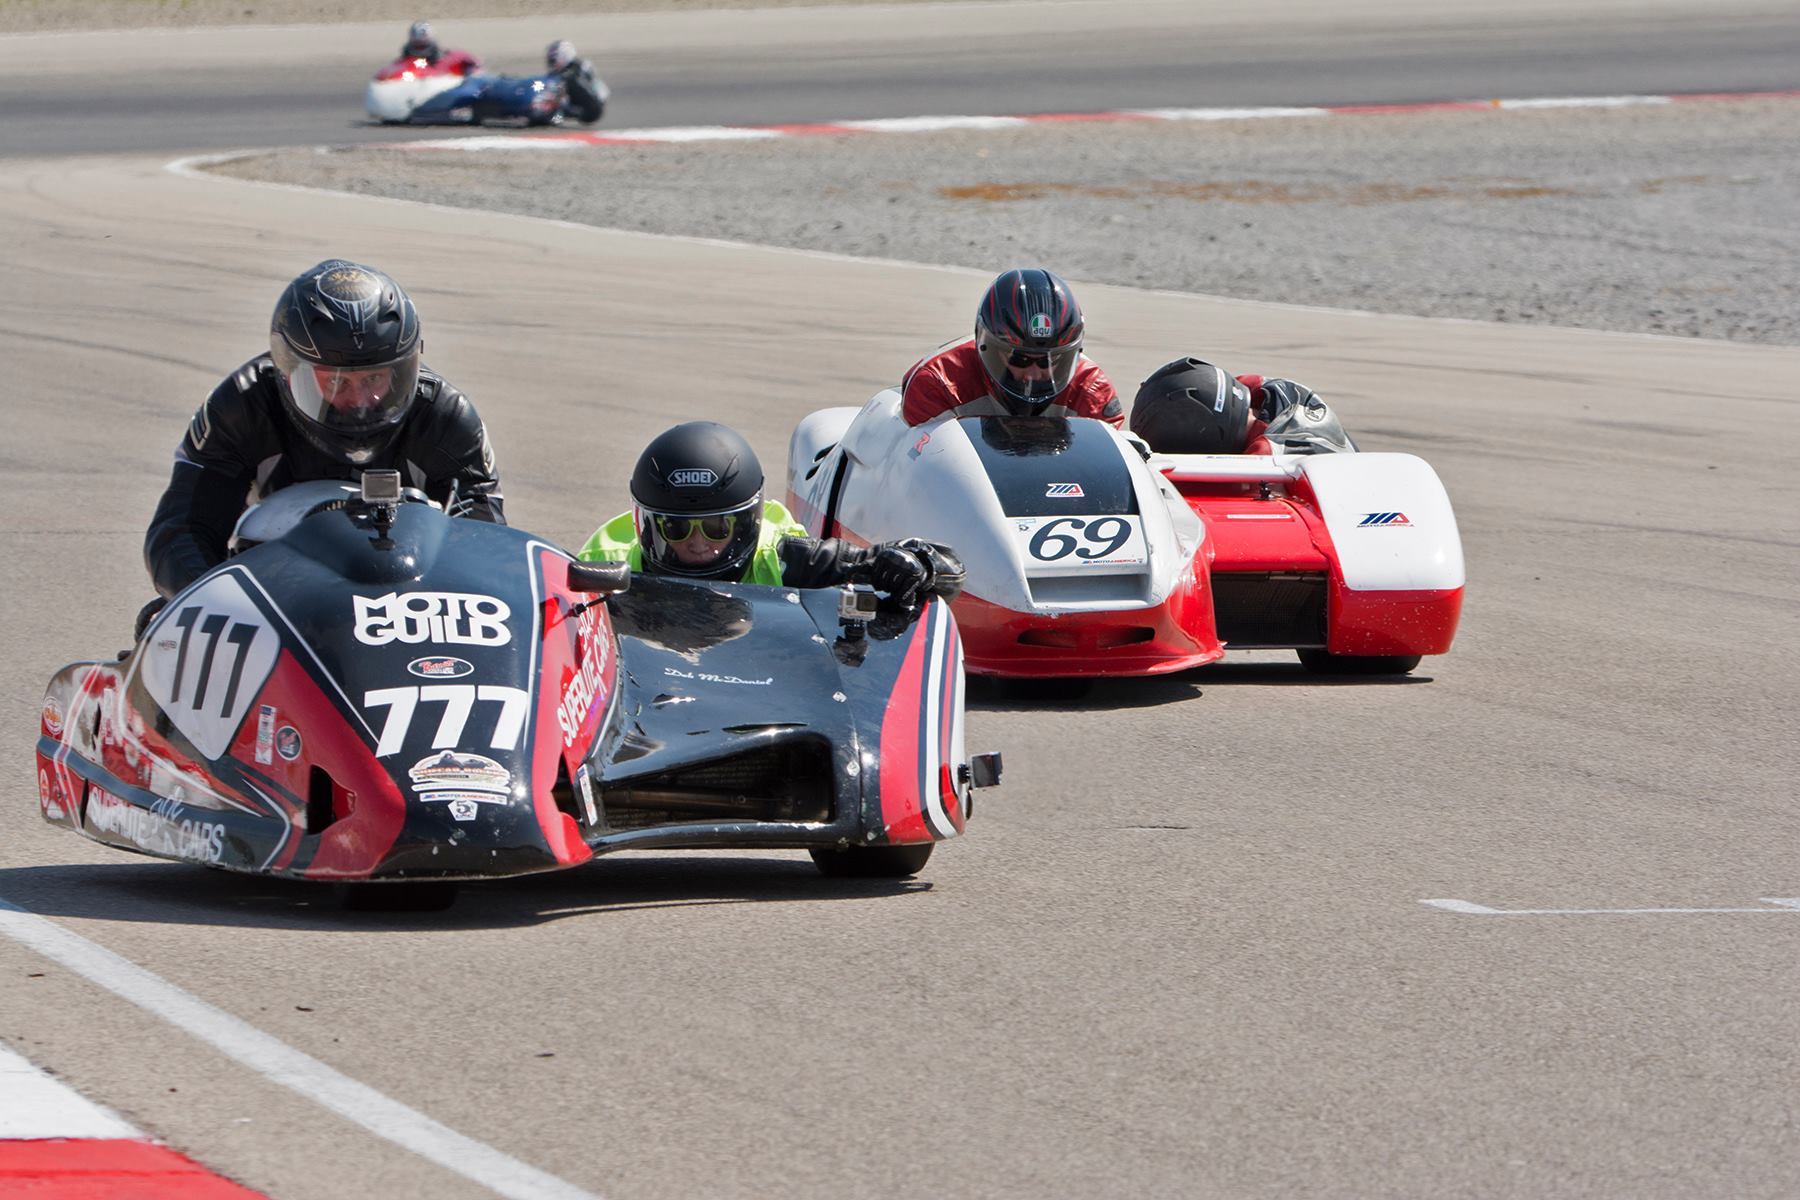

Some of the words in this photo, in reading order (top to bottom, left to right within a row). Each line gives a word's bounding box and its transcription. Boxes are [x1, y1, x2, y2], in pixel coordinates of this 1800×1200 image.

[673, 470, 712, 484] SHOEI
[1028, 517, 1132, 562] 69
[352, 591, 511, 622] MOTO
[353, 616, 512, 647] GUILD
[663, 667, 695, 679] Deb
[697, 673, 774, 686] McDaniel
[556, 646, 601, 748] SUPERLITE
[363, 685, 528, 758] 777
[178, 818, 226, 864] CARS
